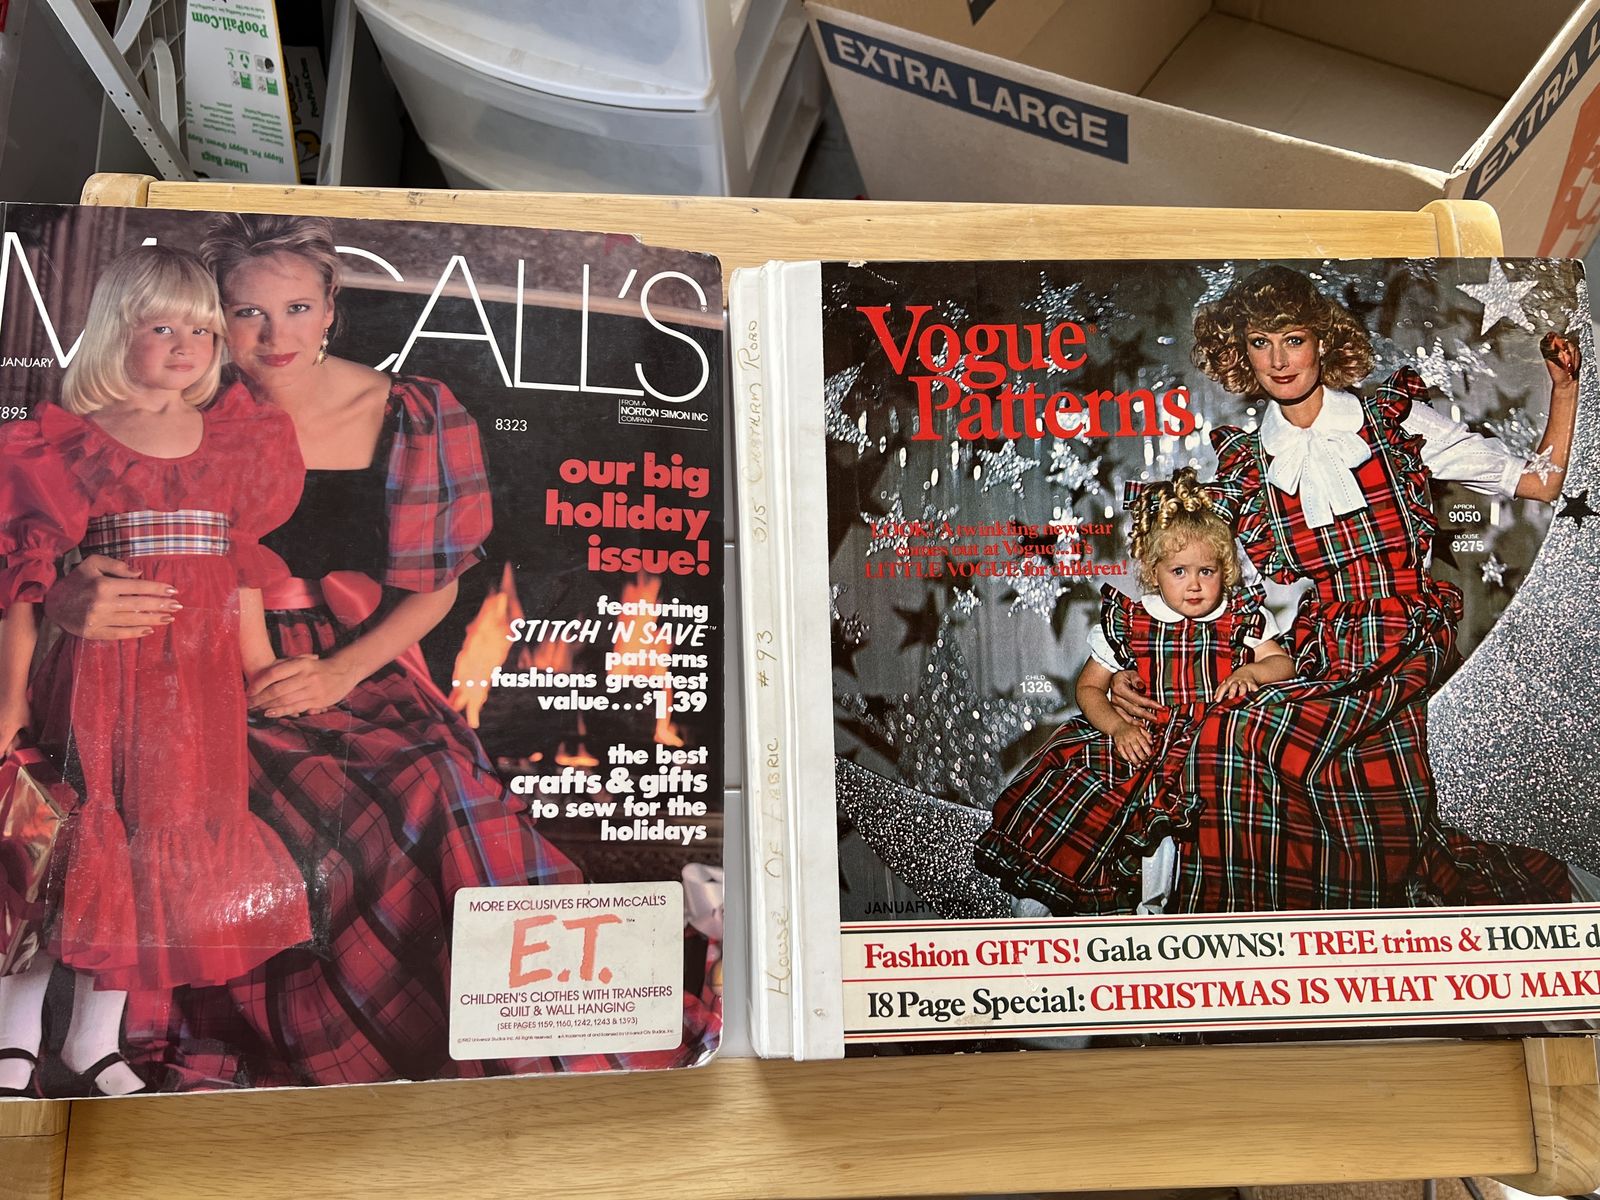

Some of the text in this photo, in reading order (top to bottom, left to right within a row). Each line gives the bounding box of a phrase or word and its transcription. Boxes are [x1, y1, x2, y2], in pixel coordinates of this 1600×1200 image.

[191, 11, 268, 38] PooPail.Com
[833, 33, 1109, 148] EXTRA LARGE
[1475, 51, 1579, 194] EXTRA
[201, 151, 249, 173] Liner Bags
[856, 305, 1088, 390] Vogue
[1, 356, 54, 368] JANUARY
[0, 406, 28, 420] 895
[621, 406, 708, 421] NORTON SIMON INC
[621, 415, 653, 423] COMPANY
[908, 375, 1196, 441] Patterns
[495, 418, 528, 433] 8323
[559, 452, 709, 498] our big
[545, 489, 710, 540] holiday
[1448, 511, 1481, 523] 9050
[870, 520, 1113, 538] LOOK! A twinkling new star
[587, 534, 710, 576] issue!
[895, 545, 949, 557] comes
[951, 544, 979, 556] out
[983, 543, 999, 556] at
[1452, 540, 1485, 552] 9275
[864, 560, 1128, 578] LITTLE VOGUE for children!
[597, 595, 708, 622] featuring
[506, 618, 602, 644] STITCH
[607, 620, 635, 644] 'N
[756, 629, 777, 661] 93
[605, 649, 708, 670] patterns
[605, 671, 708, 693] greatest
[1020, 681, 1053, 694] 1326
[608, 744, 708, 765] the best
[510, 766, 708, 799] crafts & gifts
[531, 796, 707, 819] to sew for the
[600, 819, 707, 846] holidays
[469, 895, 666, 912] MORE EXCLUSIVES FROM McCALL'S
[509, 914, 623, 988] E.T.
[864, 942, 970, 969] Fashion
[975, 938, 1080, 966] GIFTS!
[1086, 936, 1152, 964] Gala
[1157, 932, 1285, 959] GOWNS!
[1290, 929, 1378, 956] TREE
[1381, 929, 1453, 954] trims
[1457, 927, 1482, 952] &
[1485, 924, 1580, 952] HOME
[460, 986, 673, 1005] CHILDREN'S CLOTHES WITH TRANSFERS
[898, 991, 966, 1023] Page
[973, 986, 1086, 1021] Special:
[1090, 978, 1291, 1012] CHRISTMAS
[1297, 976, 1330, 1004] IS
[1335, 974, 1438, 1004] WHAT
[1444, 973, 1512, 1001] YOU
[500, 1001, 635, 1017] QUILT & WALL HANGING
[513, 1020, 536, 1030] PAGES
[537, 1020, 555, 1029] 1159,
[574, 1018, 592, 1027] 1242,
[594, 1017, 611, 1026] 1243
[612, 1017, 618, 1025] &
[619, 1017, 638, 1026] 1393)
